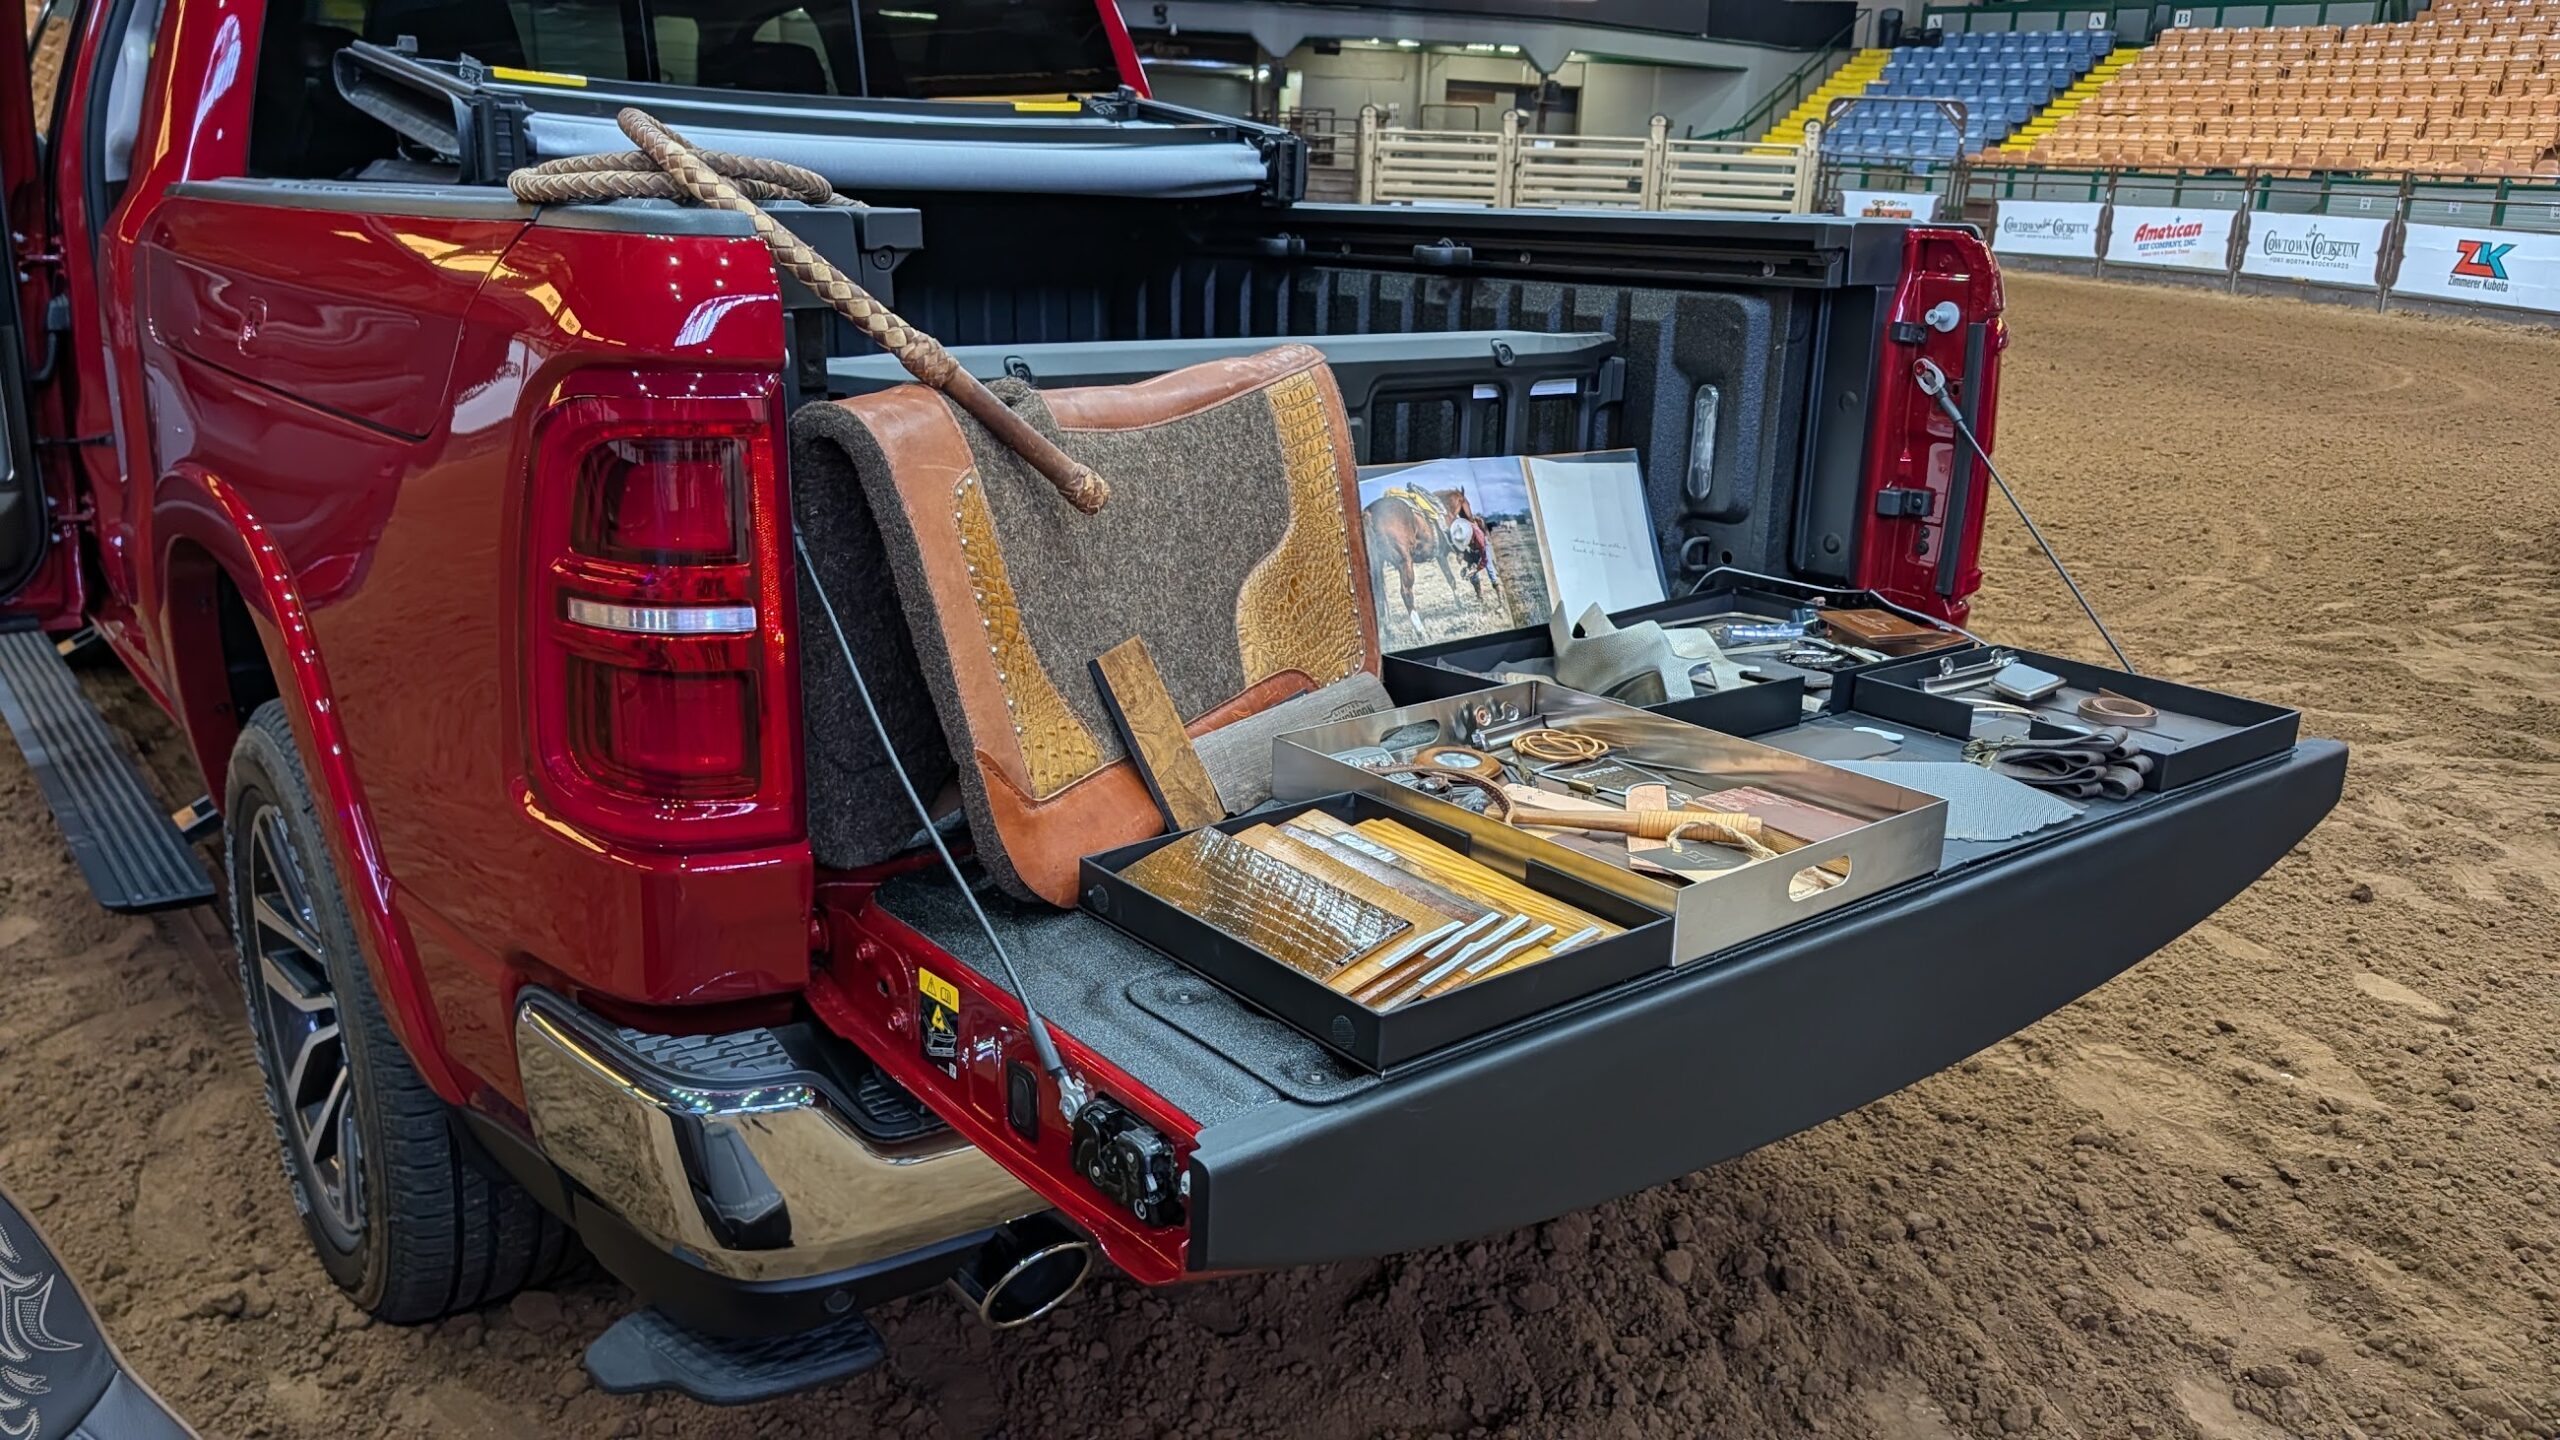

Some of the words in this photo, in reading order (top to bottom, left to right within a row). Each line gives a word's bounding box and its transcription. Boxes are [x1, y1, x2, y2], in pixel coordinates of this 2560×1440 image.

[1931, 17, 1940, 28] A
[2093, 15, 2102, 26] A
[2177, 14, 2188, 24] B
[2133, 223, 2203, 243] American
[2264, 229, 2311, 256] COWTOWN
[2311, 233, 2360, 260] COLISEUM
[2451, 239, 2518, 280] ZK
[2448, 275, 2481, 289] Zimmerer
[2483, 279, 2509, 292] Kubota
